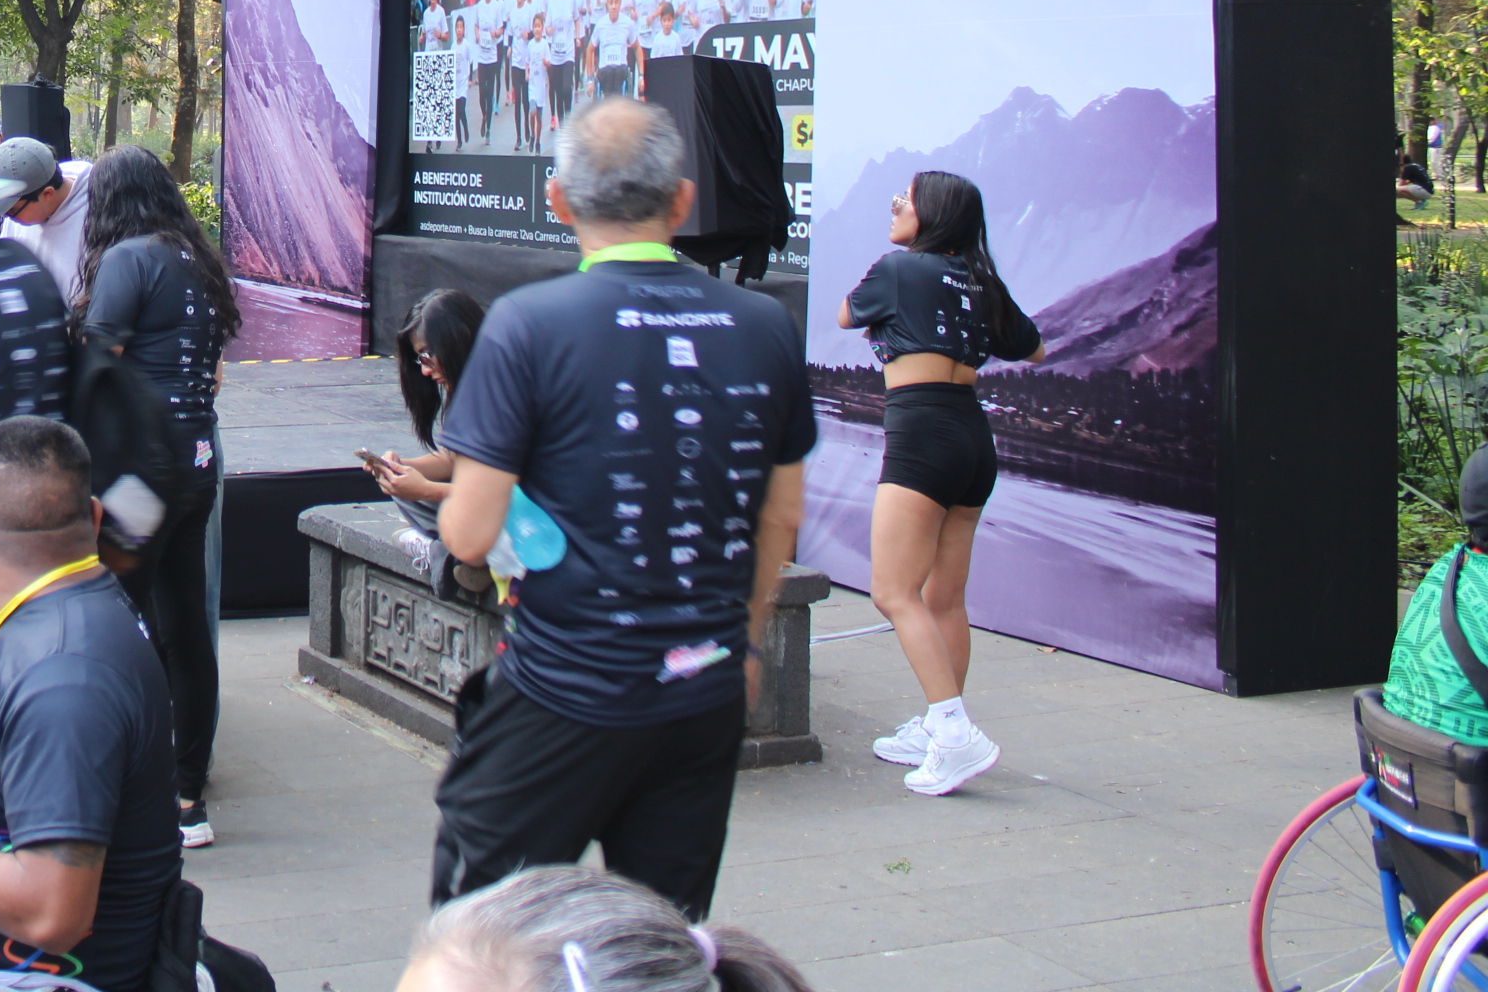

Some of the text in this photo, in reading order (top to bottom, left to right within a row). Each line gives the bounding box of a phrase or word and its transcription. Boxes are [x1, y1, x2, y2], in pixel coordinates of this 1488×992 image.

[712, 36, 745, 60] 17
[414, 171, 483, 188] A BENEFICIO DE
[545, 166, 558, 179] CA
[414, 190, 526, 211] INSTITUCIÓN CONFE I.A.P.
[419, 221, 581, 245] asdeporte.com Busca la carrera: 12va Carrera Corre
[641, 312, 736, 327] BANORTE
